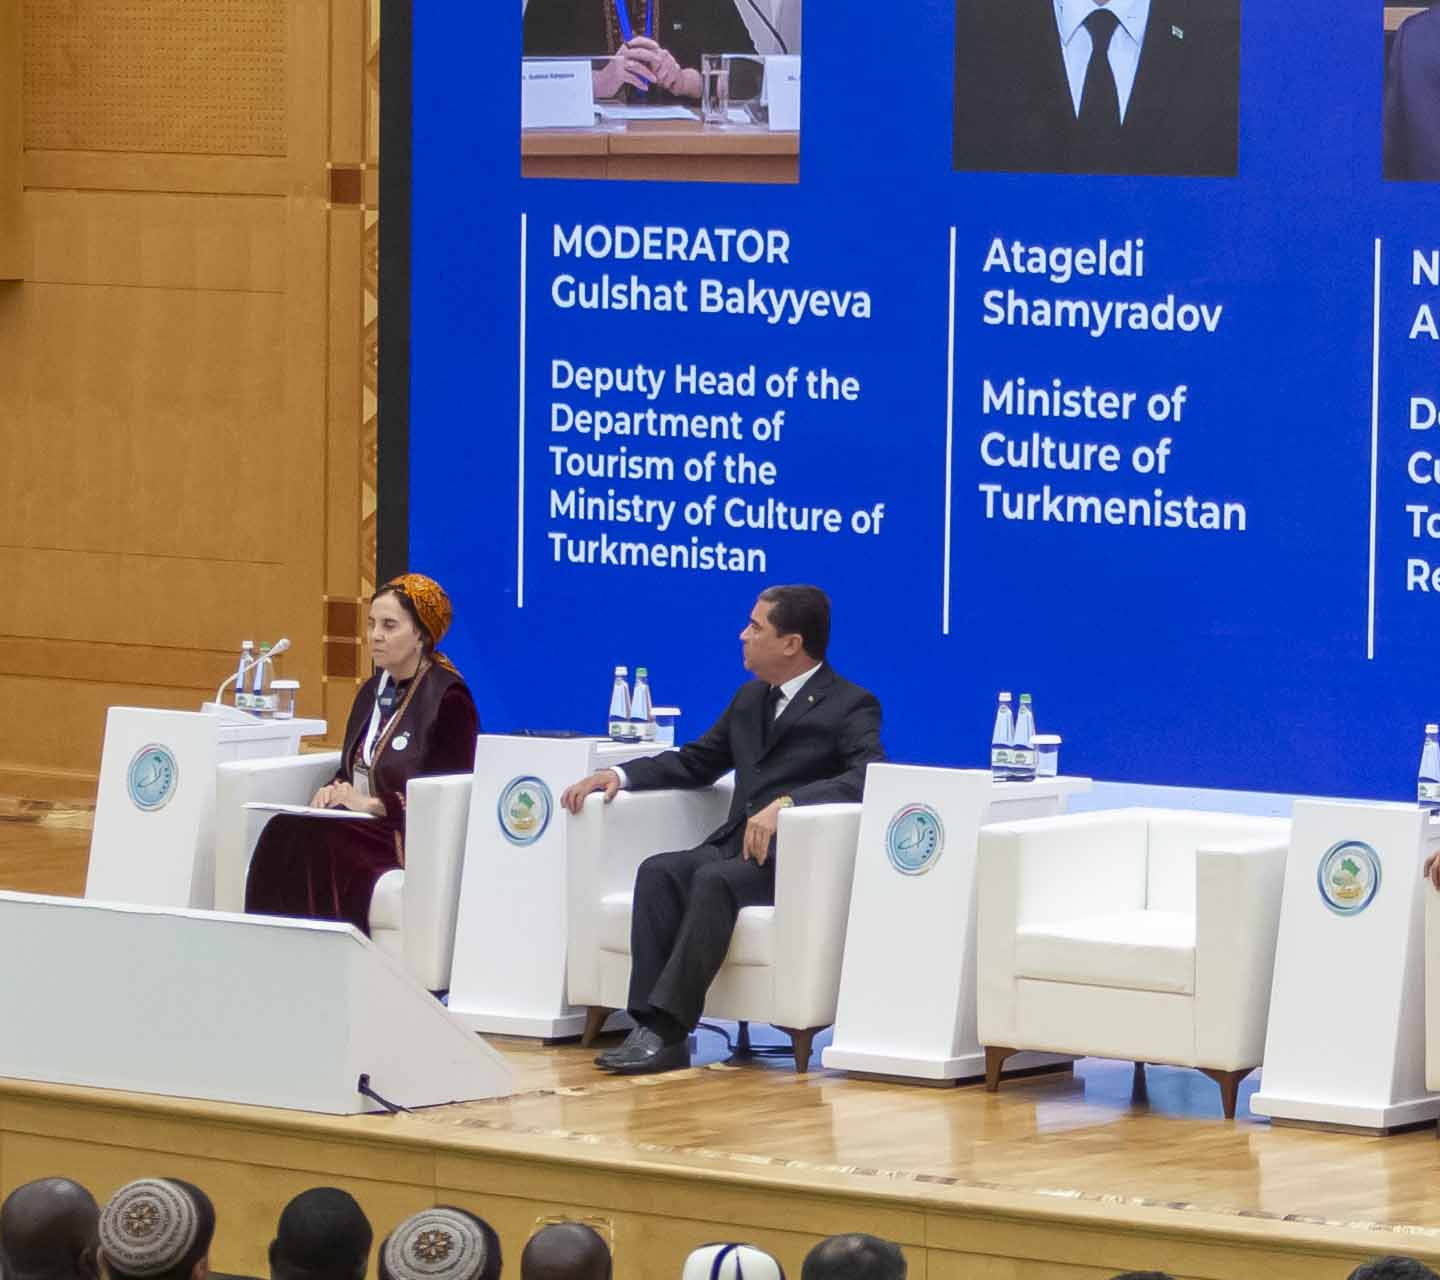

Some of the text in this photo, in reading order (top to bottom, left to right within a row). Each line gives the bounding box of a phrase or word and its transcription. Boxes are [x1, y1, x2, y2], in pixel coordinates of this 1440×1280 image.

[553, 223, 790, 264] MODERATOR
[982, 237, 1144, 284] Atageldi
[551, 273, 871, 325] Gulshat Bakyyeva
[983, 288, 1223, 338] Shamyradov
[551, 359, 860, 401] Deputy Head of the
[982, 377, 1188, 422] Minister of
[551, 402, 785, 442] Department of
[548, 445, 777, 486] Tourism of the
[980, 431, 1172, 474] Culture of
[550, 487, 885, 535] Ministry of Culture of
[978, 483, 1246, 531] Turkmenistan
[547, 532, 766, 573] Turkmenistan
